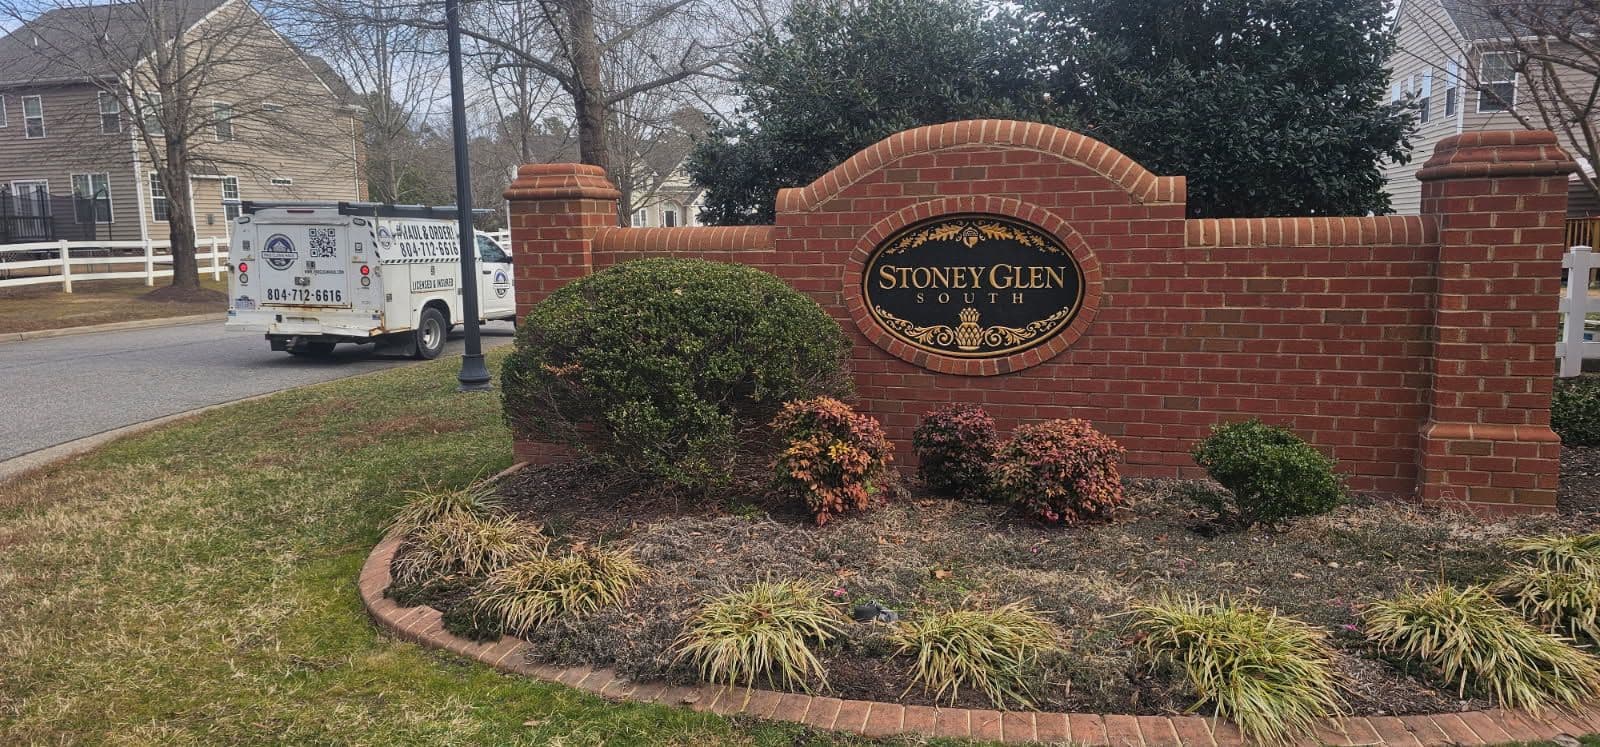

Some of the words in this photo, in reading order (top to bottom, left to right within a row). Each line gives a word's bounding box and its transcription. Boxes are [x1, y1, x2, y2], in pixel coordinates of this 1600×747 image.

[422, 225, 429, 240] &
[879, 264, 986, 289] STONEY
[989, 263, 1066, 289] GLEN
[267, 288, 342, 302] 804-712-6616
[916, 292, 1024, 304] SOUTH
